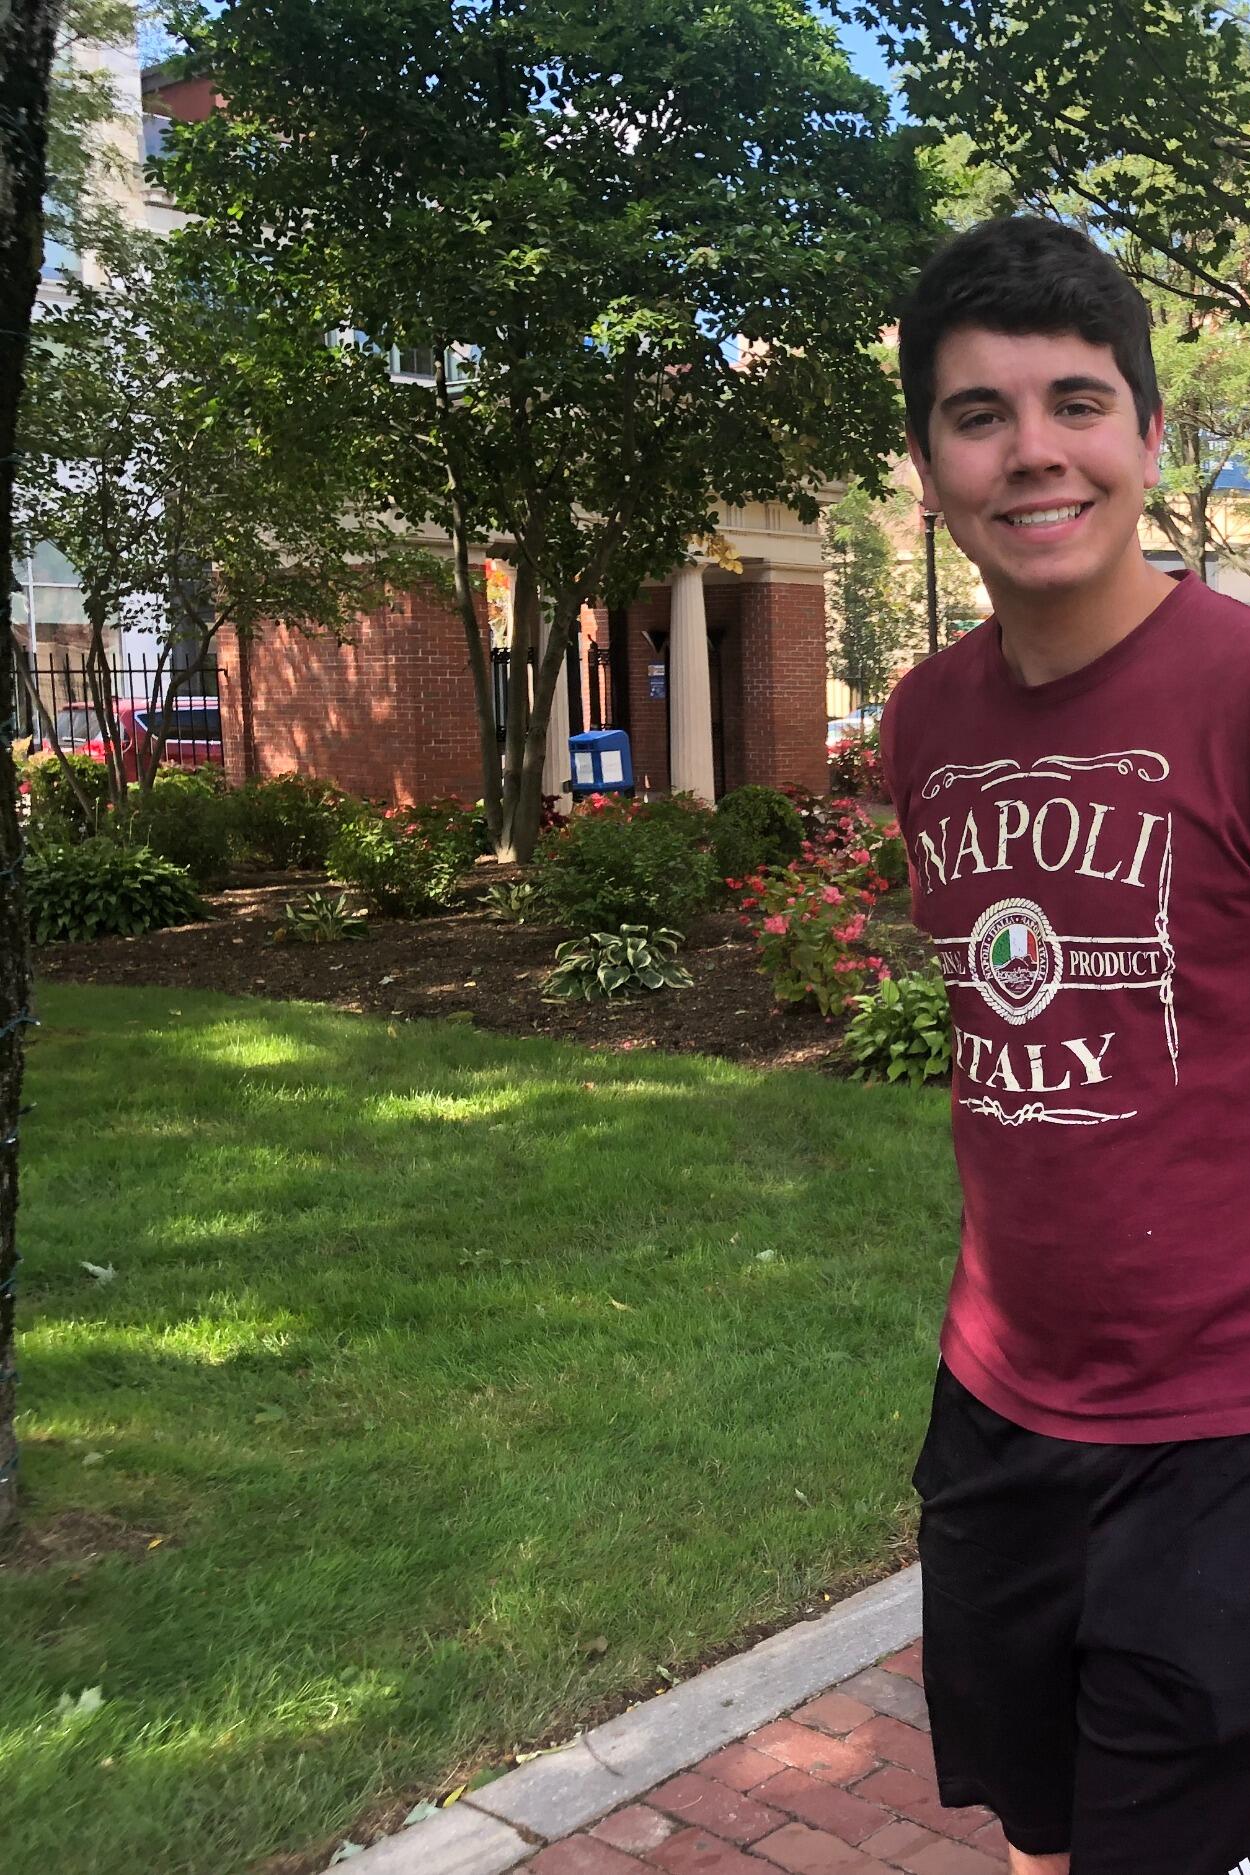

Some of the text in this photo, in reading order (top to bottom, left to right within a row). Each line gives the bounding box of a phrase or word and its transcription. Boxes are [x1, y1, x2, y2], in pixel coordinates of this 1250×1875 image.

[915, 797, 1165, 894] NAPOLI
[989, 916, 1016, 938] ITALIA
[1069, 950, 1160, 977] PRODUCT
[954, 1025, 1116, 1093] ITALY
